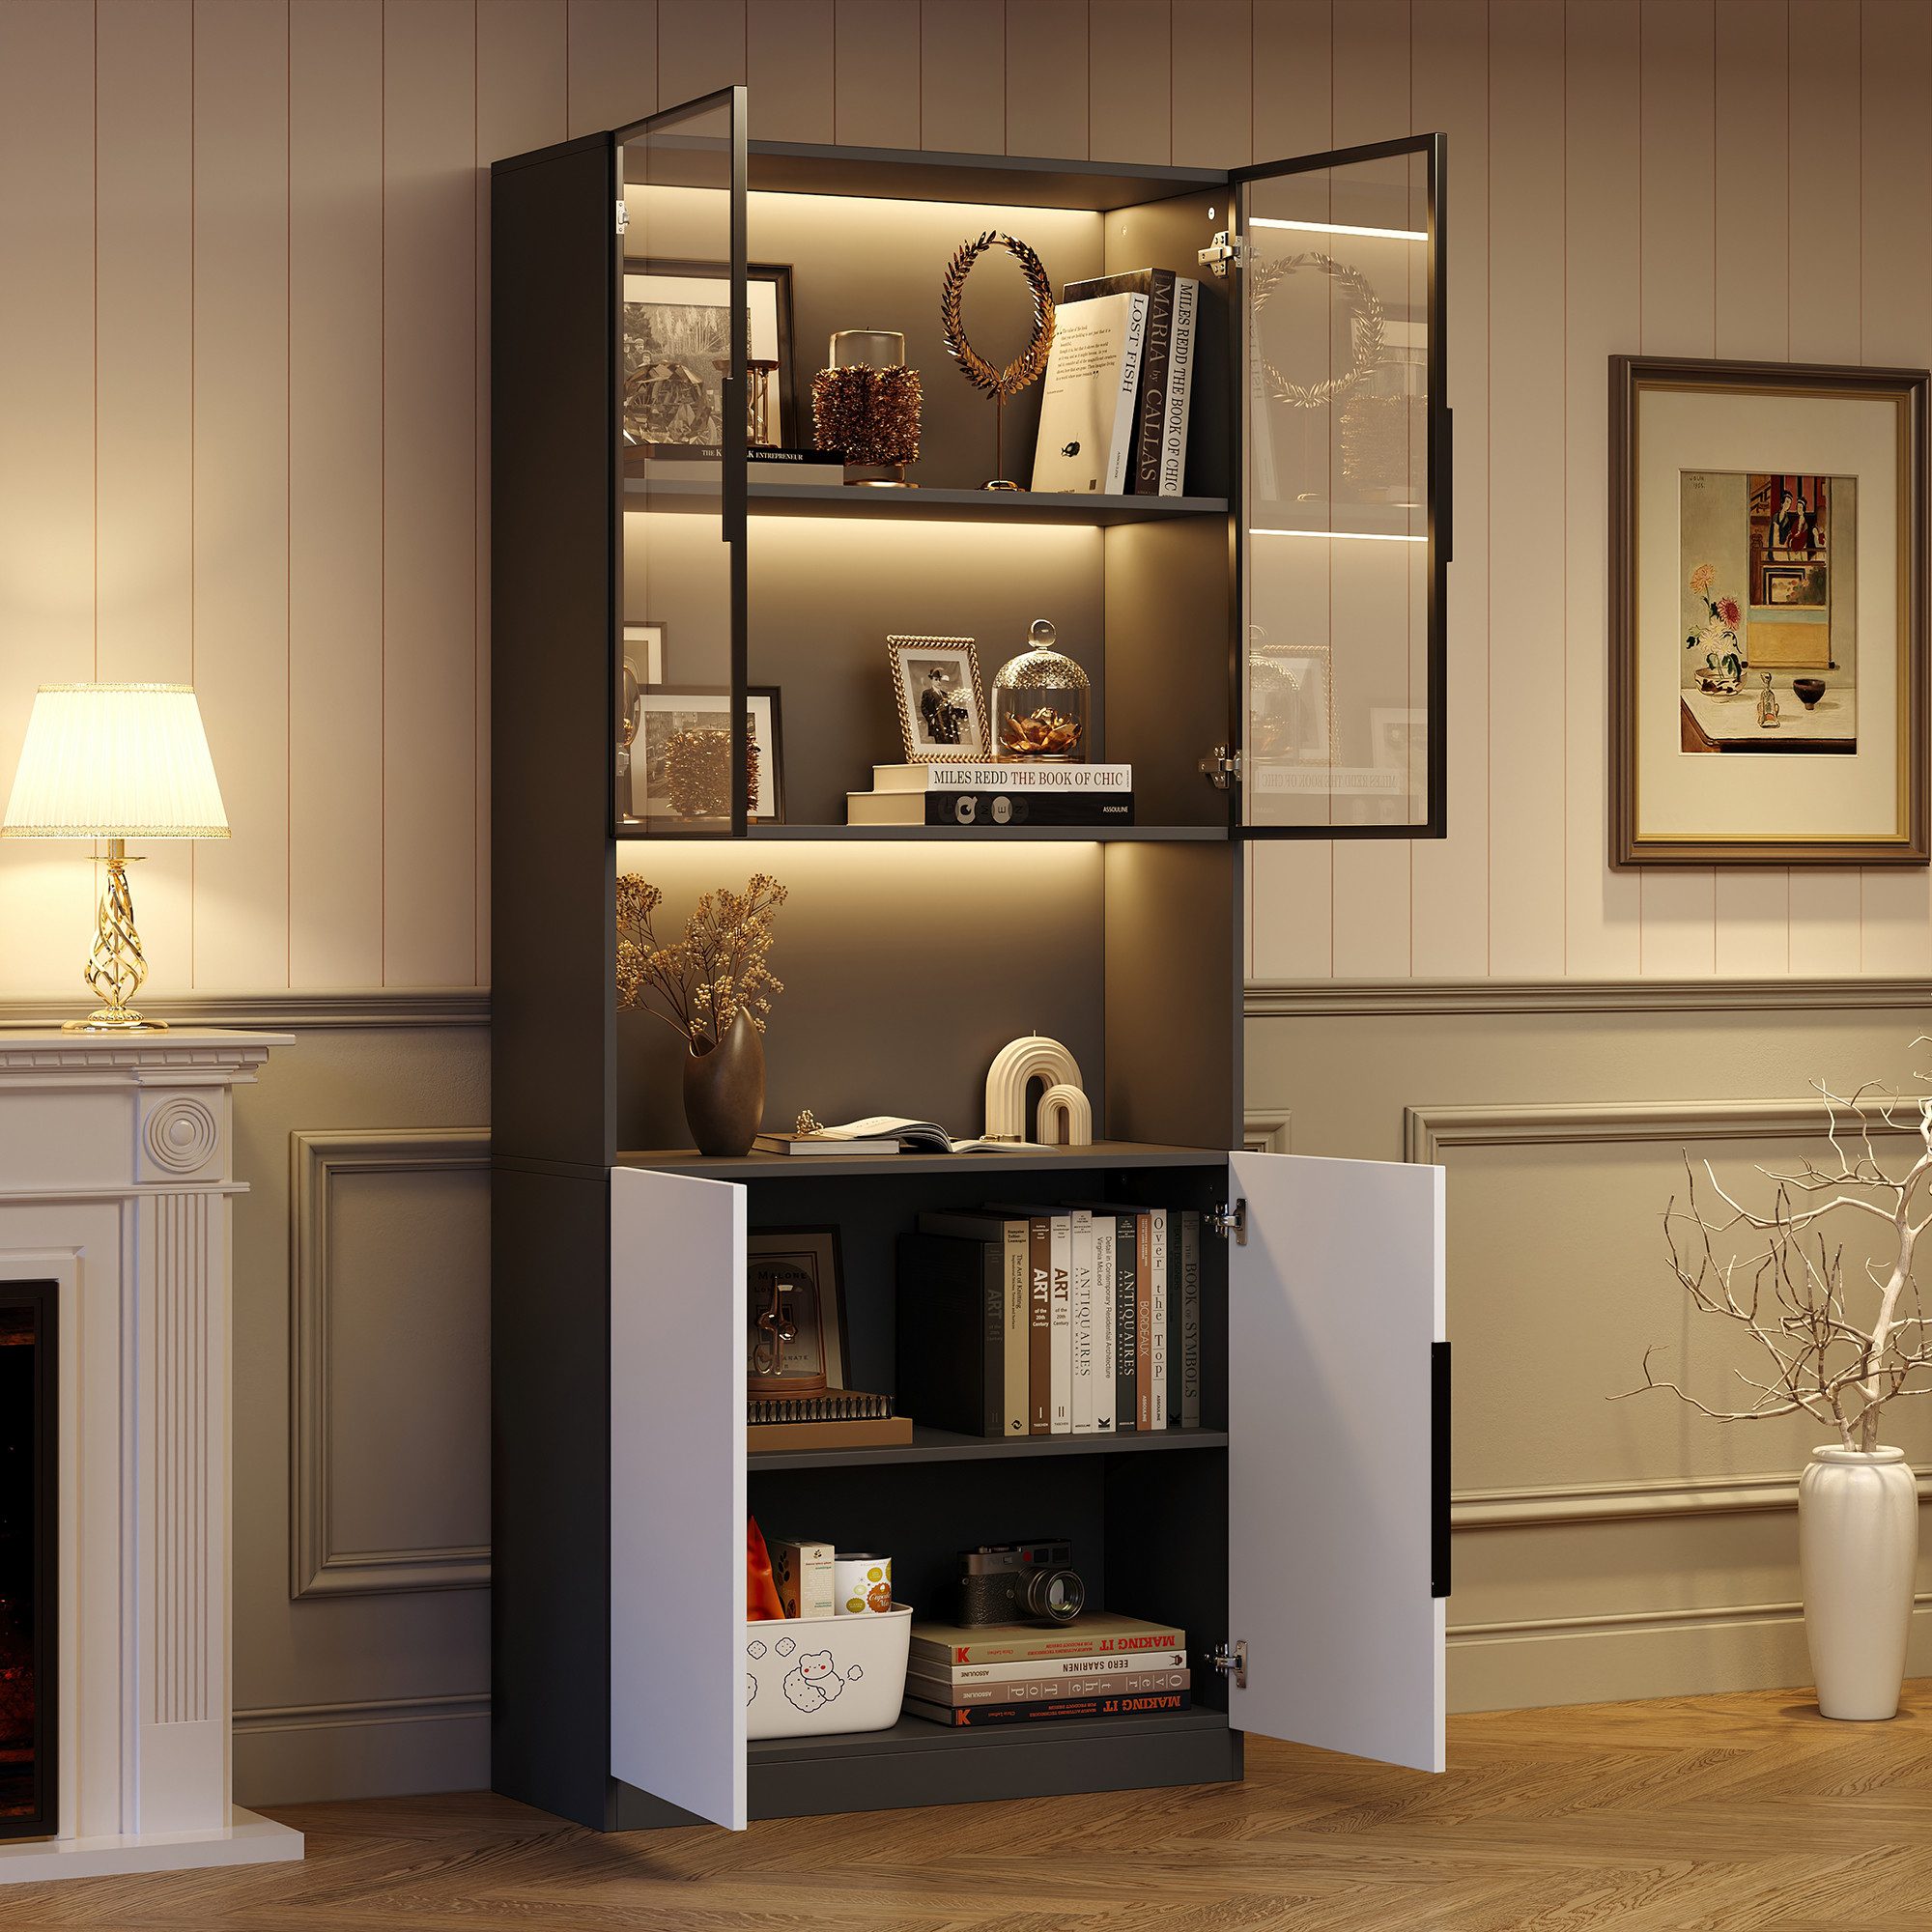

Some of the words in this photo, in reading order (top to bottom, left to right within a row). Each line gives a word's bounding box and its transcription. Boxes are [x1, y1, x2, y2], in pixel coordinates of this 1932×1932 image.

[1179, 284, 1193, 327] MILES
[1129, 298, 1144, 347] LOST
[1151, 282, 1171, 362] MARIA
[1176, 327, 1189, 365] REDD
[1122, 351, 1138, 394] FISH
[1151, 370, 1162, 382] by
[1173, 367, 1186, 395] THE
[1169, 397, 1183, 436] BOOK
[1140, 388, 1162, 482] CALLAS
[1166, 438, 1180, 456] OF
[755, 452, 804, 461] ENTREPRENEUR
[1164, 459, 1179, 492] CHIC
[933, 770, 972, 785] MILES
[975, 770, 1009, 785] REDD
[1010, 771, 1037, 785] THE
[1037, 771, 1073, 786] BOOK
[1074, 771, 1092, 786] OF
[1094, 771, 1123, 786] CHIC
[1102, 805, 1128, 814] ASSOULINE
[1154, 1217, 1164, 1268] Over
[1034, 1268, 1047, 1303] ART
[1054, 1267, 1068, 1301] ART
[1184, 1263, 1197, 1306] BOOK
[987, 1290, 1004, 1321] ART
[1154, 1285, 1163, 1321] the
[1078, 1267, 1091, 1377] ANTIQUAIRES
[1122, 1270, 1134, 1377] ANTIQUAIRES
[1140, 1300, 1149, 1357] BORDEAUX
[1154, 1334, 1164, 1378] Top
[1184, 1322, 1198, 1399] SYMBOLS
[1099, 1638, 1115, 1651] IT
[1118, 1634, 1176, 1651] MAKING
[960, 1669, 990, 1678] ASSOULINE
[1062, 1660, 1104, 1673] SAARINEN
[1106, 1659, 1128, 1669] EERO
[962, 1690, 992, 1699] ASSOULINE
[1011, 1683, 1058, 1697] Top
[1071, 1679, 1112, 1693] the
[1126, 1674, 1183, 1689] Over
[1102, 1699, 1119, 1712] IT
[1122, 1695, 1181, 1710] MAKING
